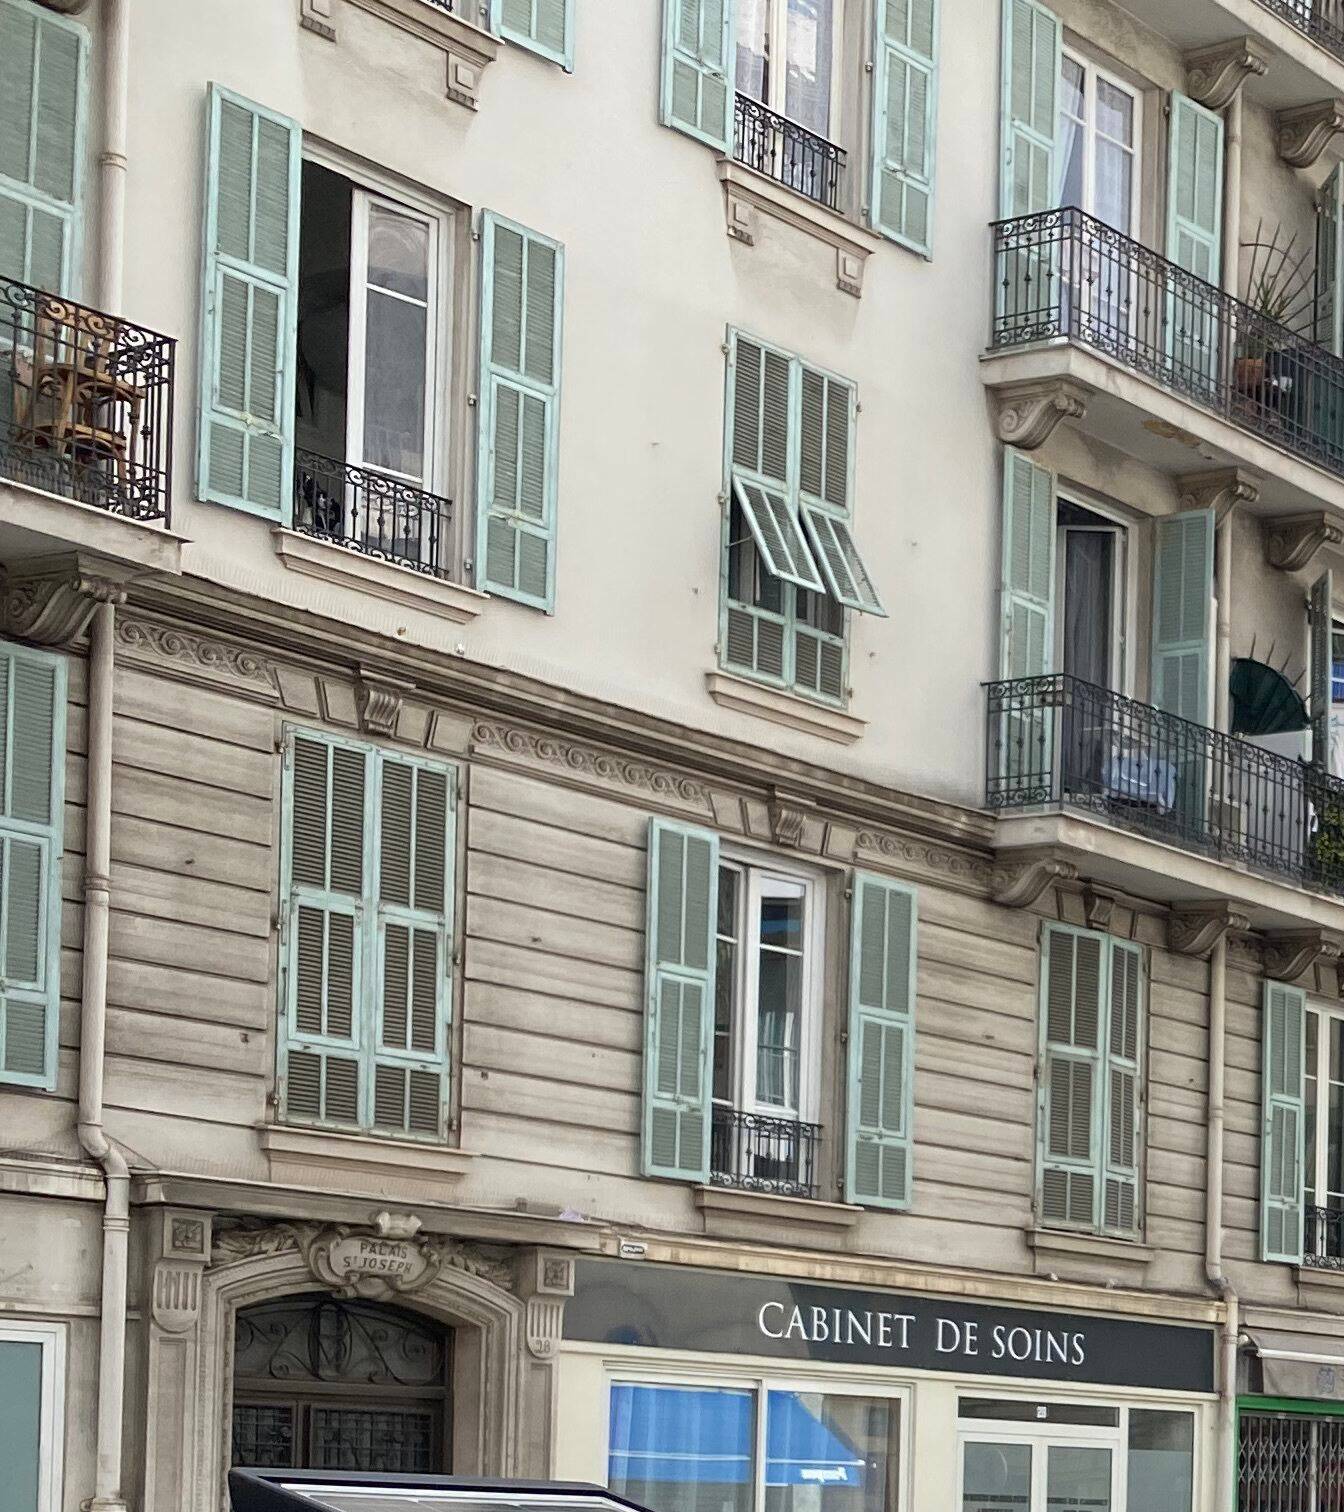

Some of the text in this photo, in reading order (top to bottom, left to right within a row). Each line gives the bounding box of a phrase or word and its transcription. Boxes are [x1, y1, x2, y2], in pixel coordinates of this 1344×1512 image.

[360, 1242, 408, 1259] PALAIS
[359, 1257, 413, 1274] JOSEPH
[758, 1300, 1086, 1366] CABINET DE SOINS
